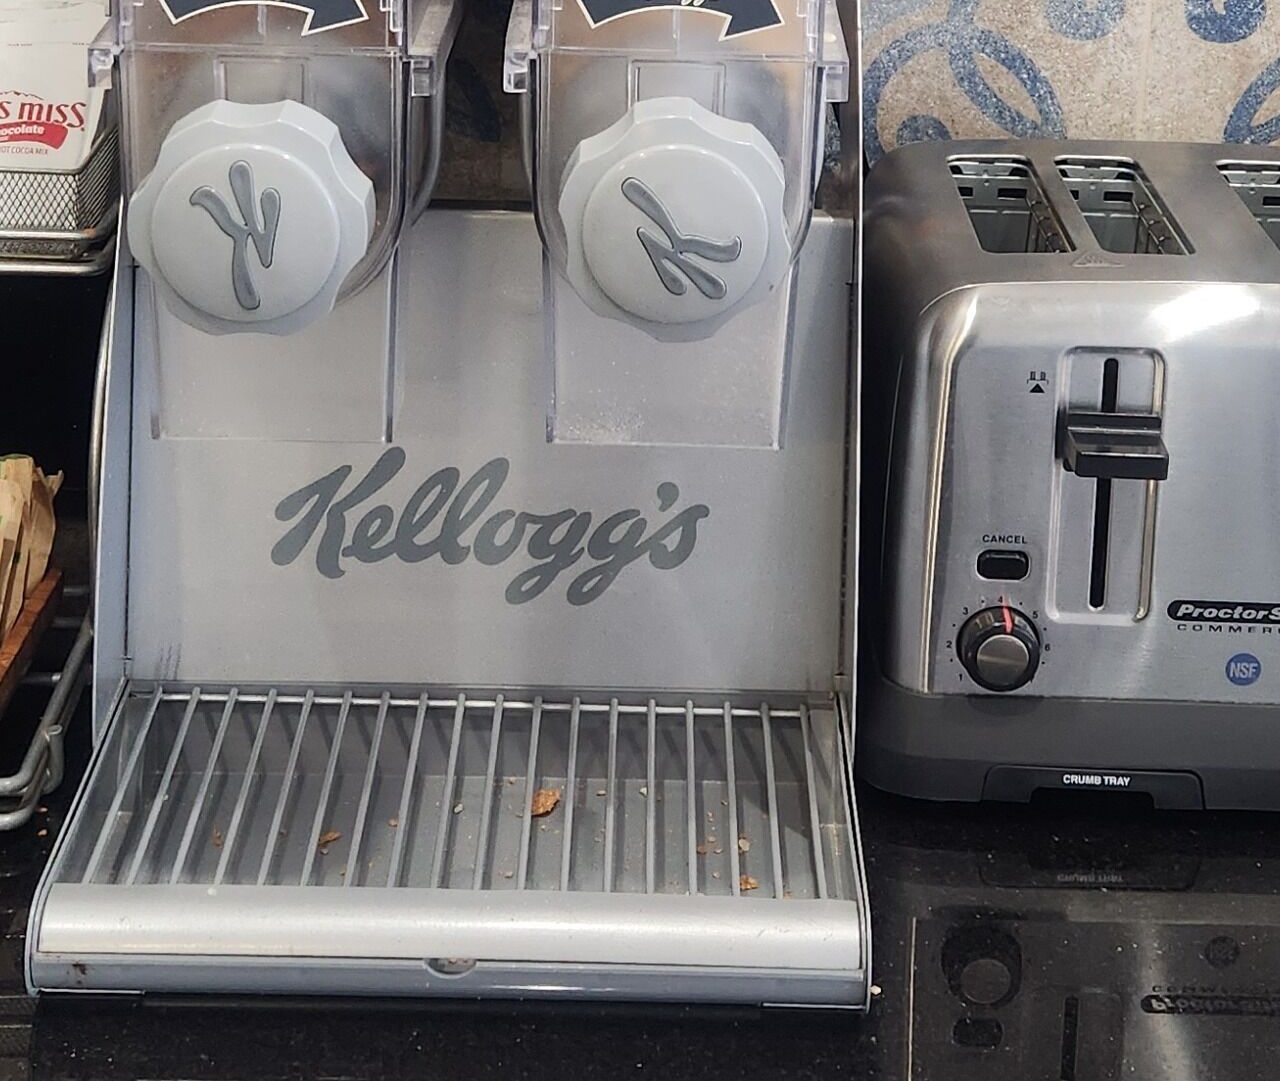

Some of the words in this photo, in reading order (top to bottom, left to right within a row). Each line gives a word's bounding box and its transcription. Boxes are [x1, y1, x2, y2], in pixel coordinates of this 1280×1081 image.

[270, 446, 710, 606] Kellogg's
[982, 534, 1028, 545] CANCEL
[997, 595, 1003, 604] 4
[962, 606, 969, 615] 3
[1032, 611, 1039, 619] 5
[946, 640, 952, 649] 2
[1044, 643, 1051, 651] 6
[1228, 662, 1259, 679] NSF
[959, 673, 963, 681] 1
[1062, 774, 1102, 786] CRUMB
[1102, 775, 1131, 788] TRAY
